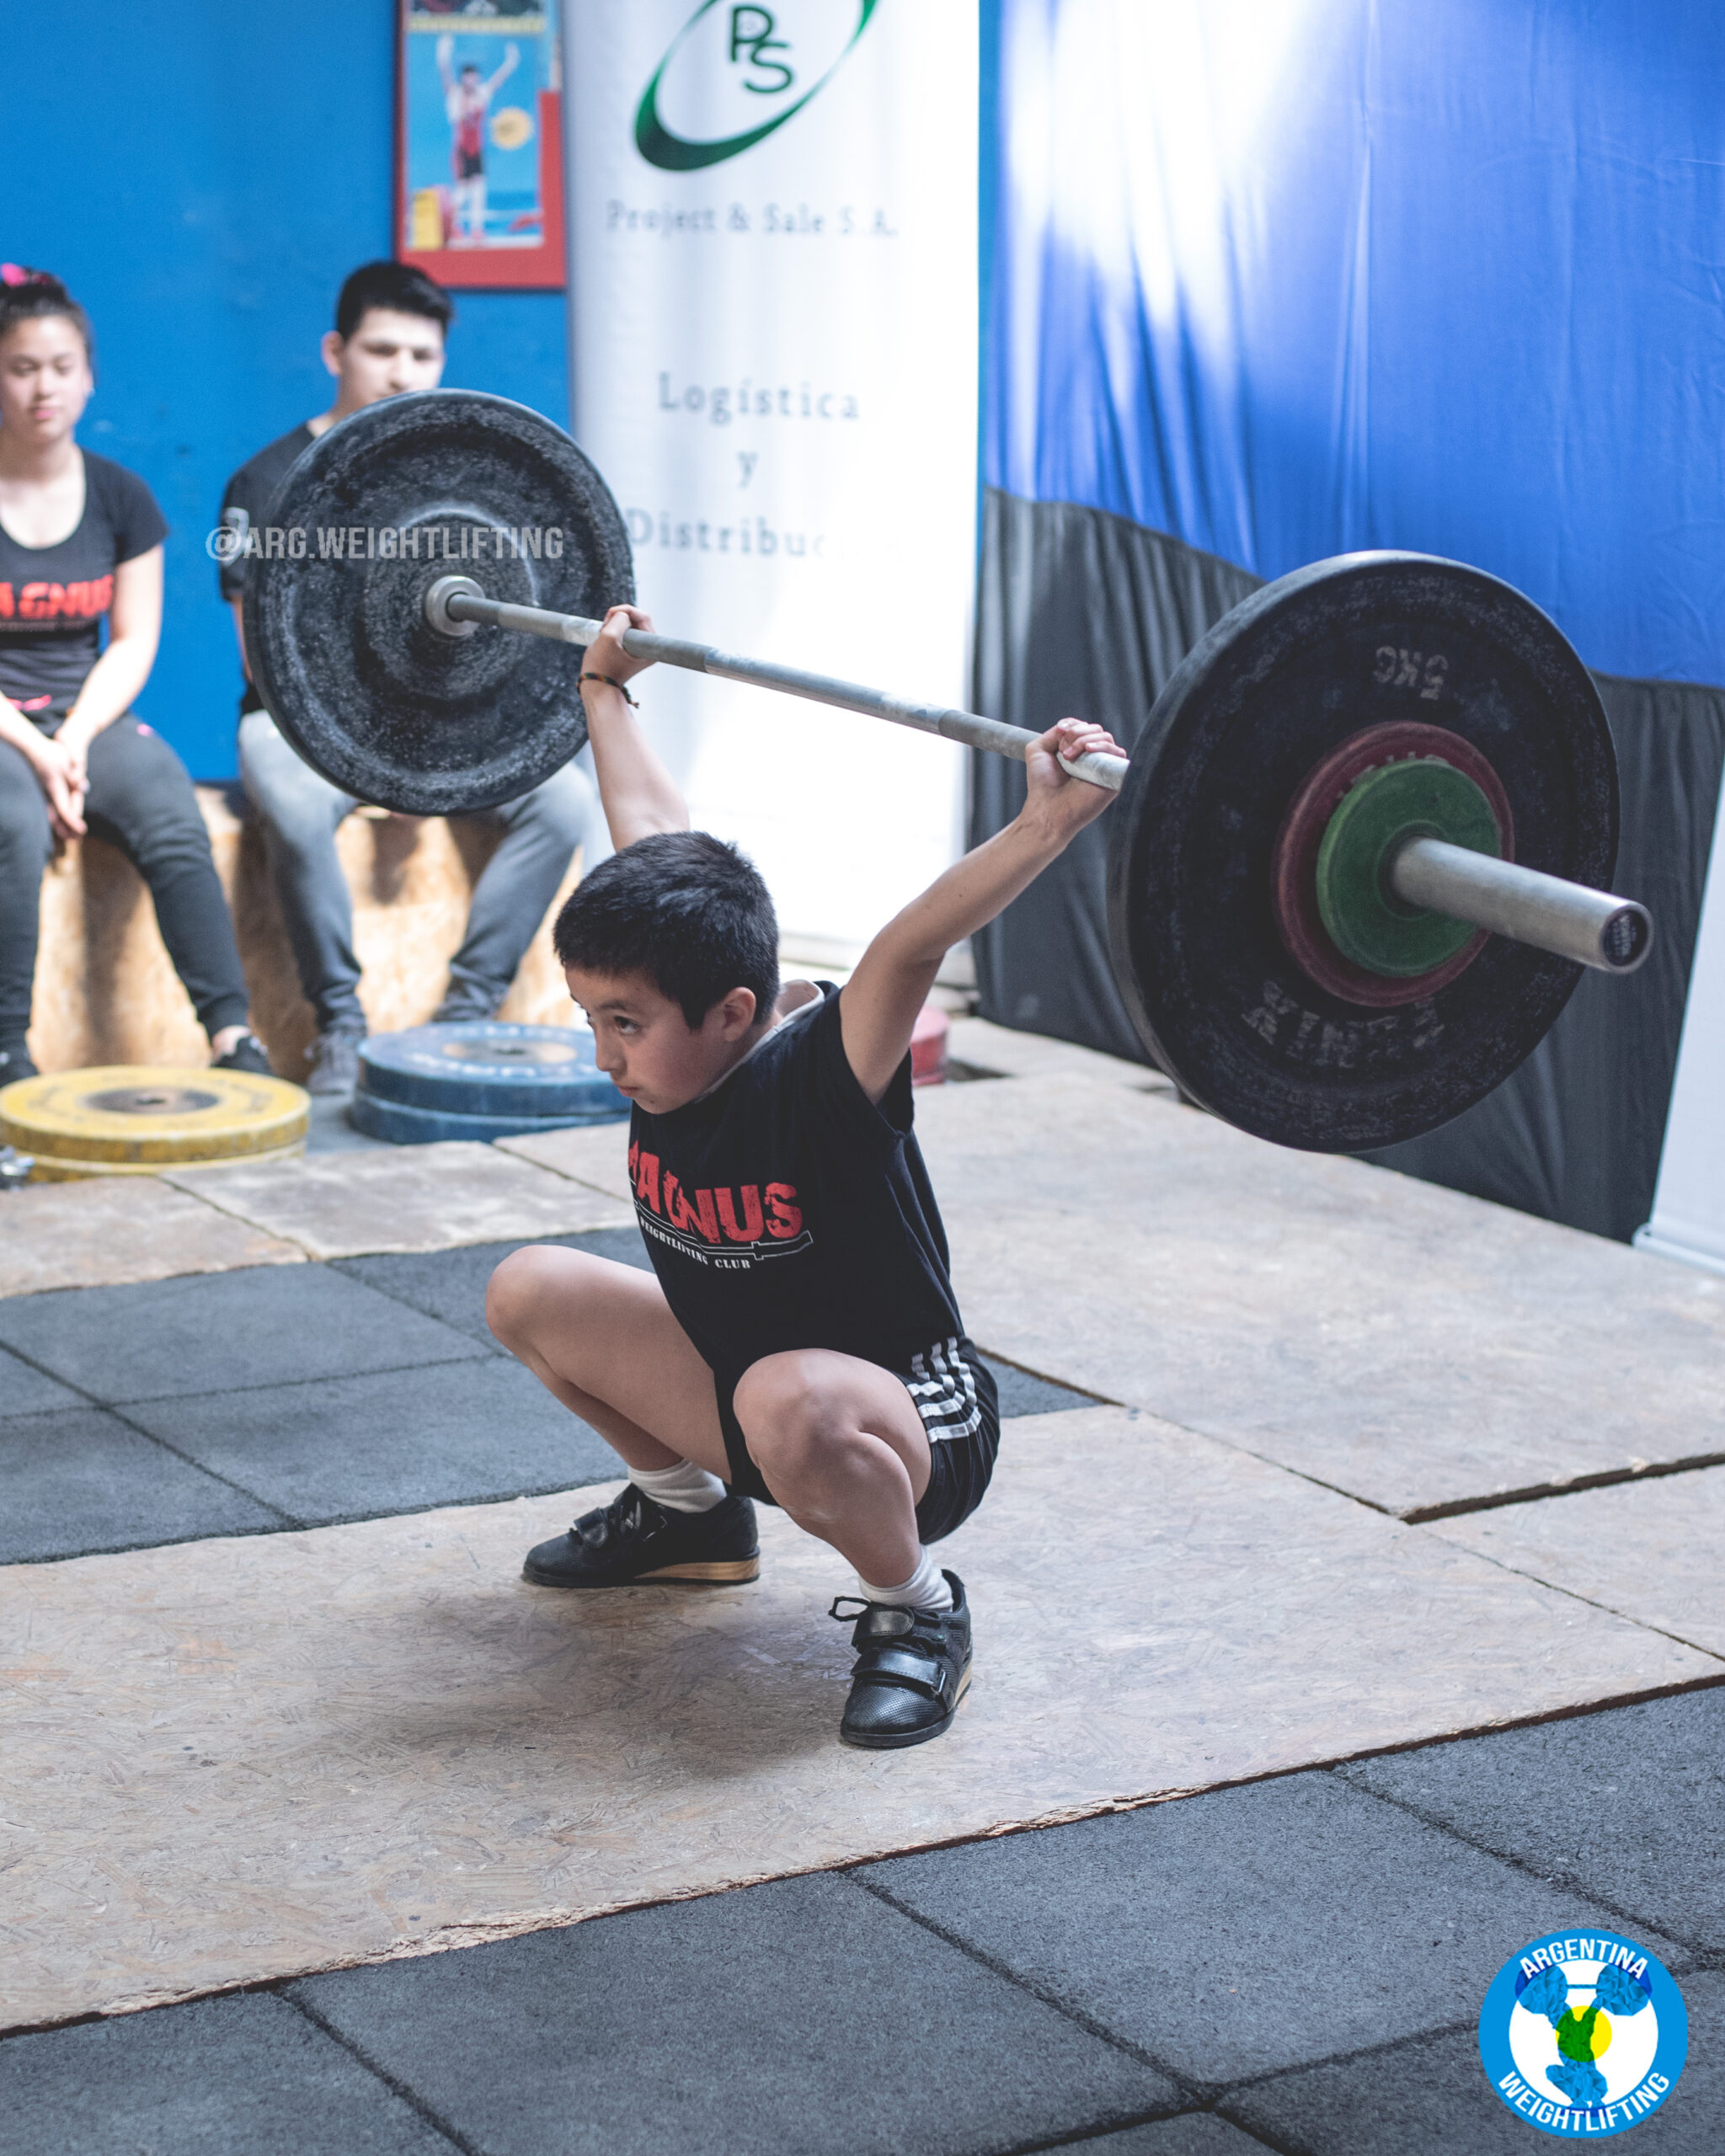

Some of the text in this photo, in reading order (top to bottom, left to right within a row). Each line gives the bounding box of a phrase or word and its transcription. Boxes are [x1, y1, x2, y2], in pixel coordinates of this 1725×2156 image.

[606, 200, 716, 238] Project
[726, 202, 750, 232] &
[762, 203, 826, 236] Sale
[657, 371, 860, 425] Logística
[736, 450, 759, 488] y
[626, 507, 826, 558] Distribuc
[1375, 645, 1450, 700] 5KG
[714, 1258, 751, 1269] CLUB
